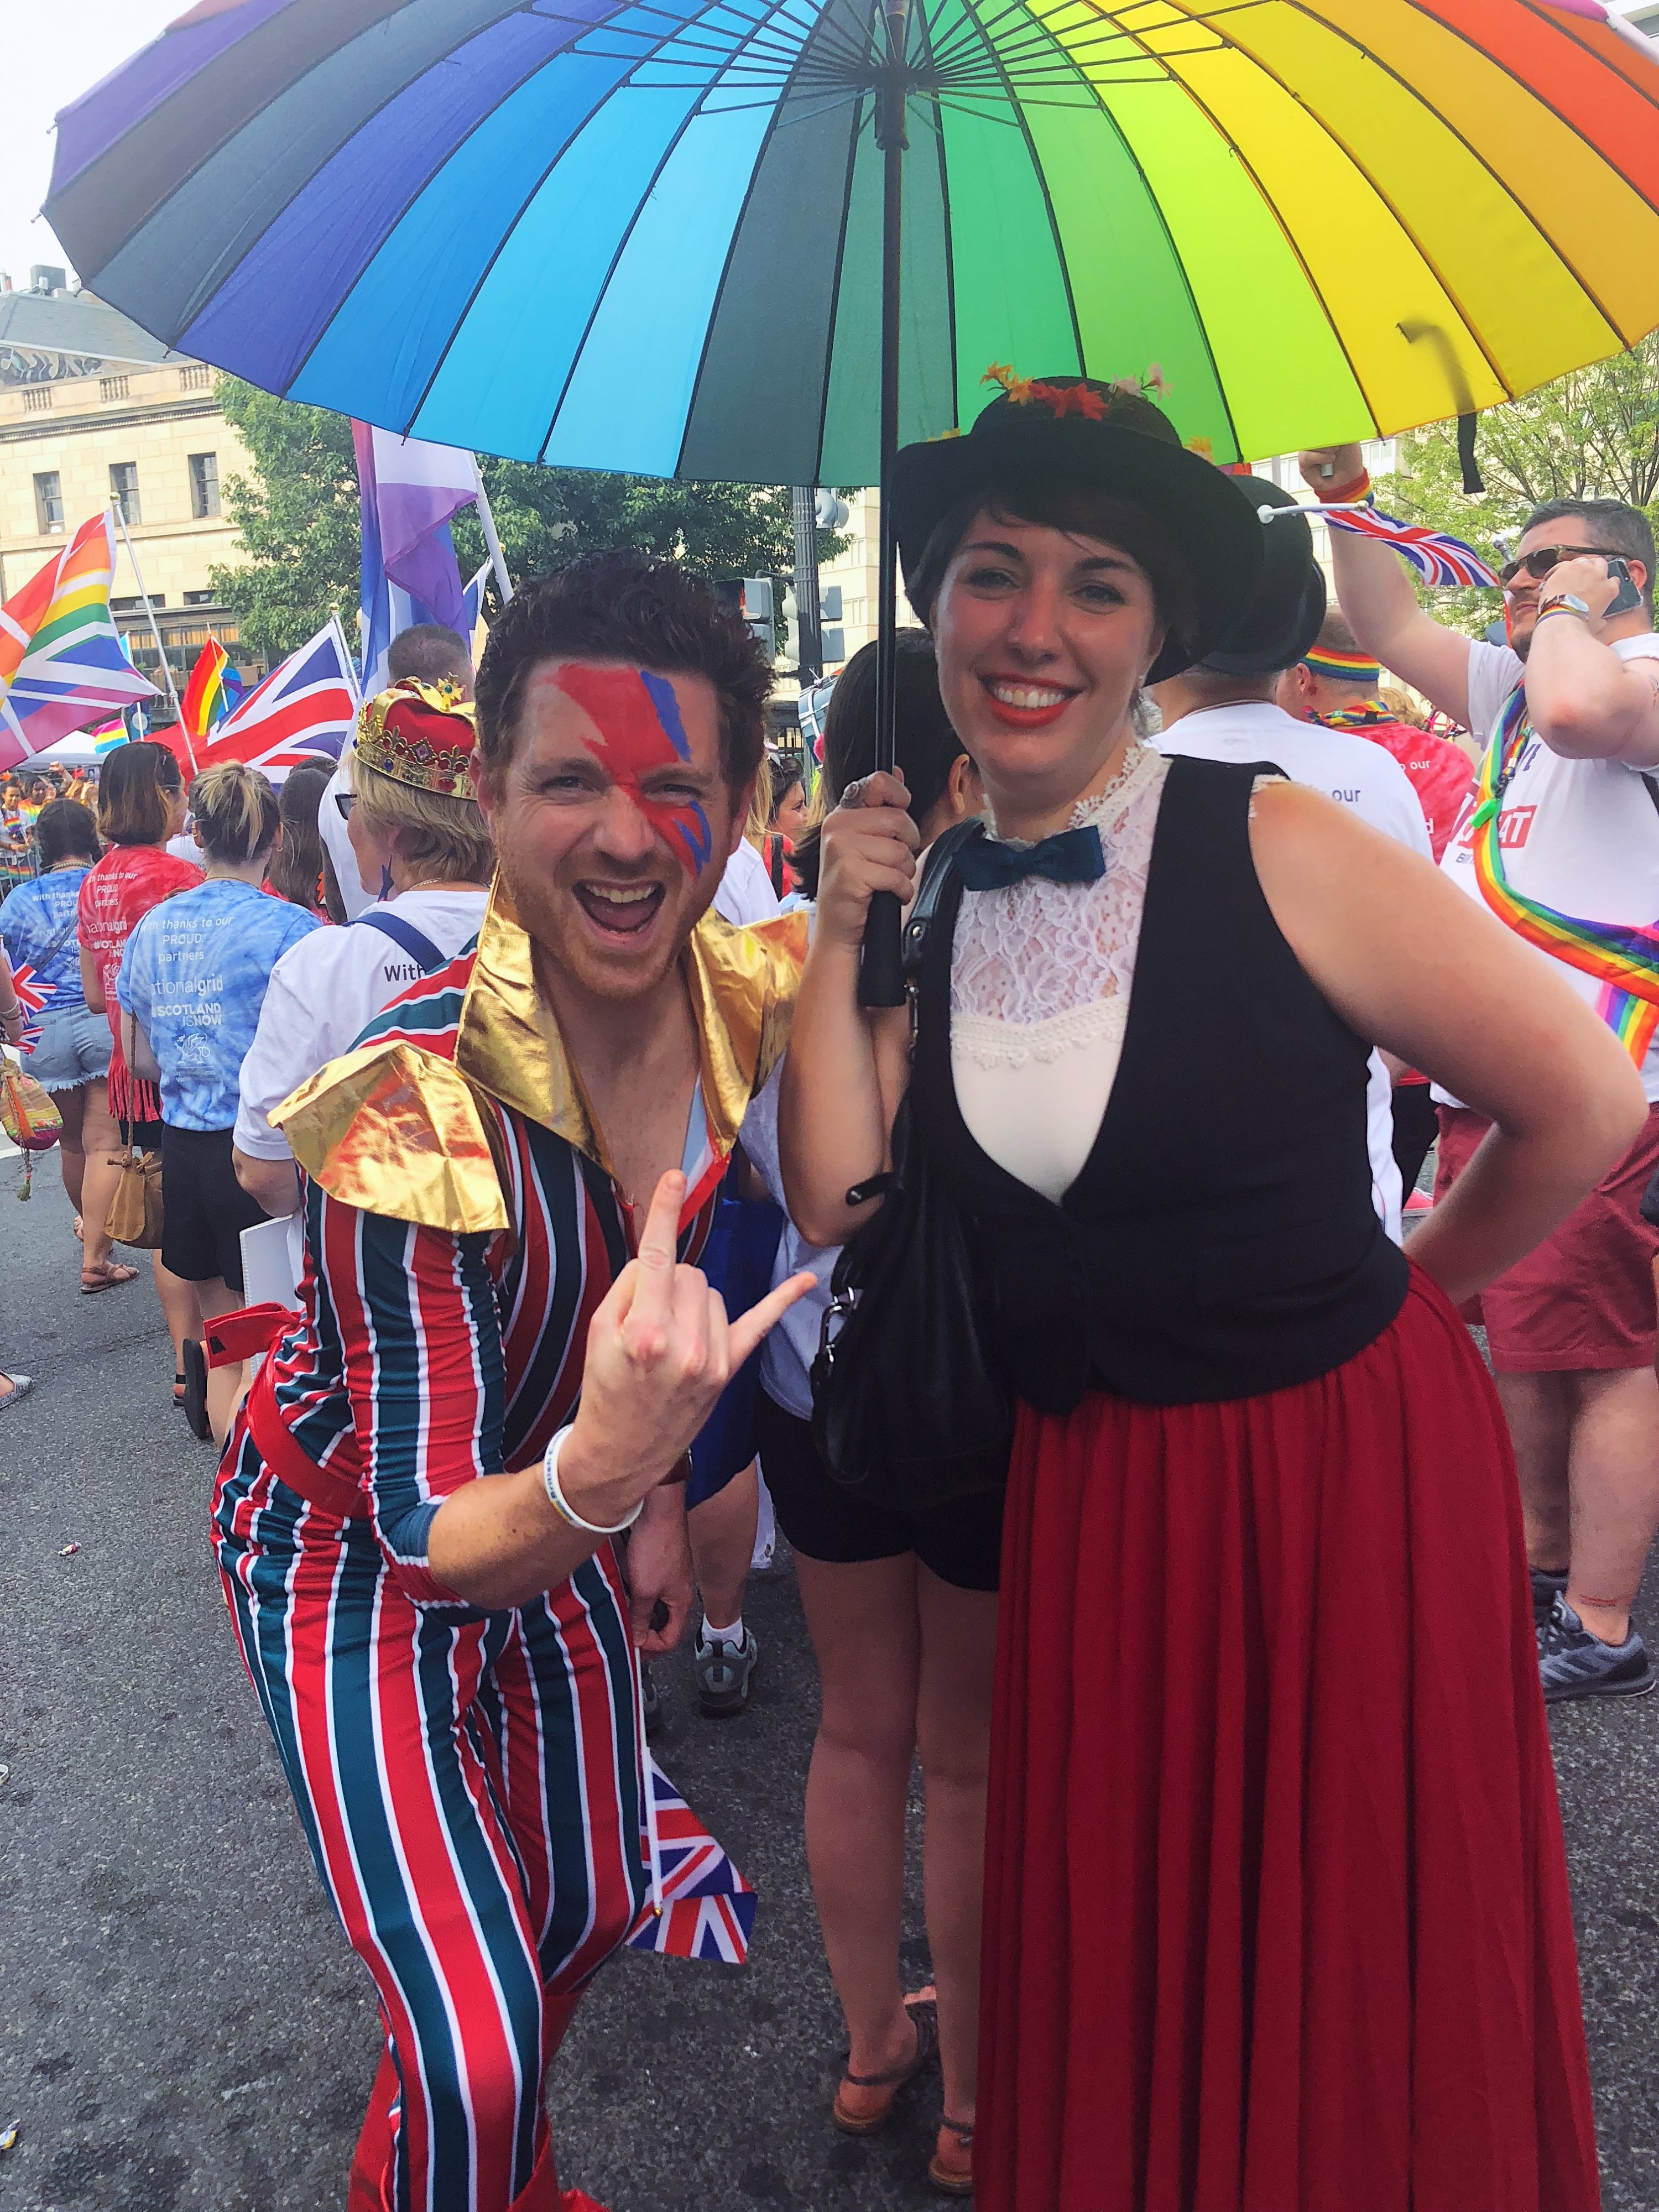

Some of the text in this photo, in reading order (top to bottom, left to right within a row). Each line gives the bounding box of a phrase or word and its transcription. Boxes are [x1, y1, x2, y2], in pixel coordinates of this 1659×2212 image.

[1410, 760, 1431, 770] our
[1332, 789, 1361, 802] our
[124, 872, 138, 880] our
[97, 883, 118, 894] PROUD
[32, 893, 50, 902] With
[162, 919, 197, 930] thanks
[202, 917, 212, 927] to
[215, 916, 234, 927] our
[162, 933, 202, 946] PROUD
[159, 951, 205, 964] partners
[183, 1014, 222, 1026] ISNOW
